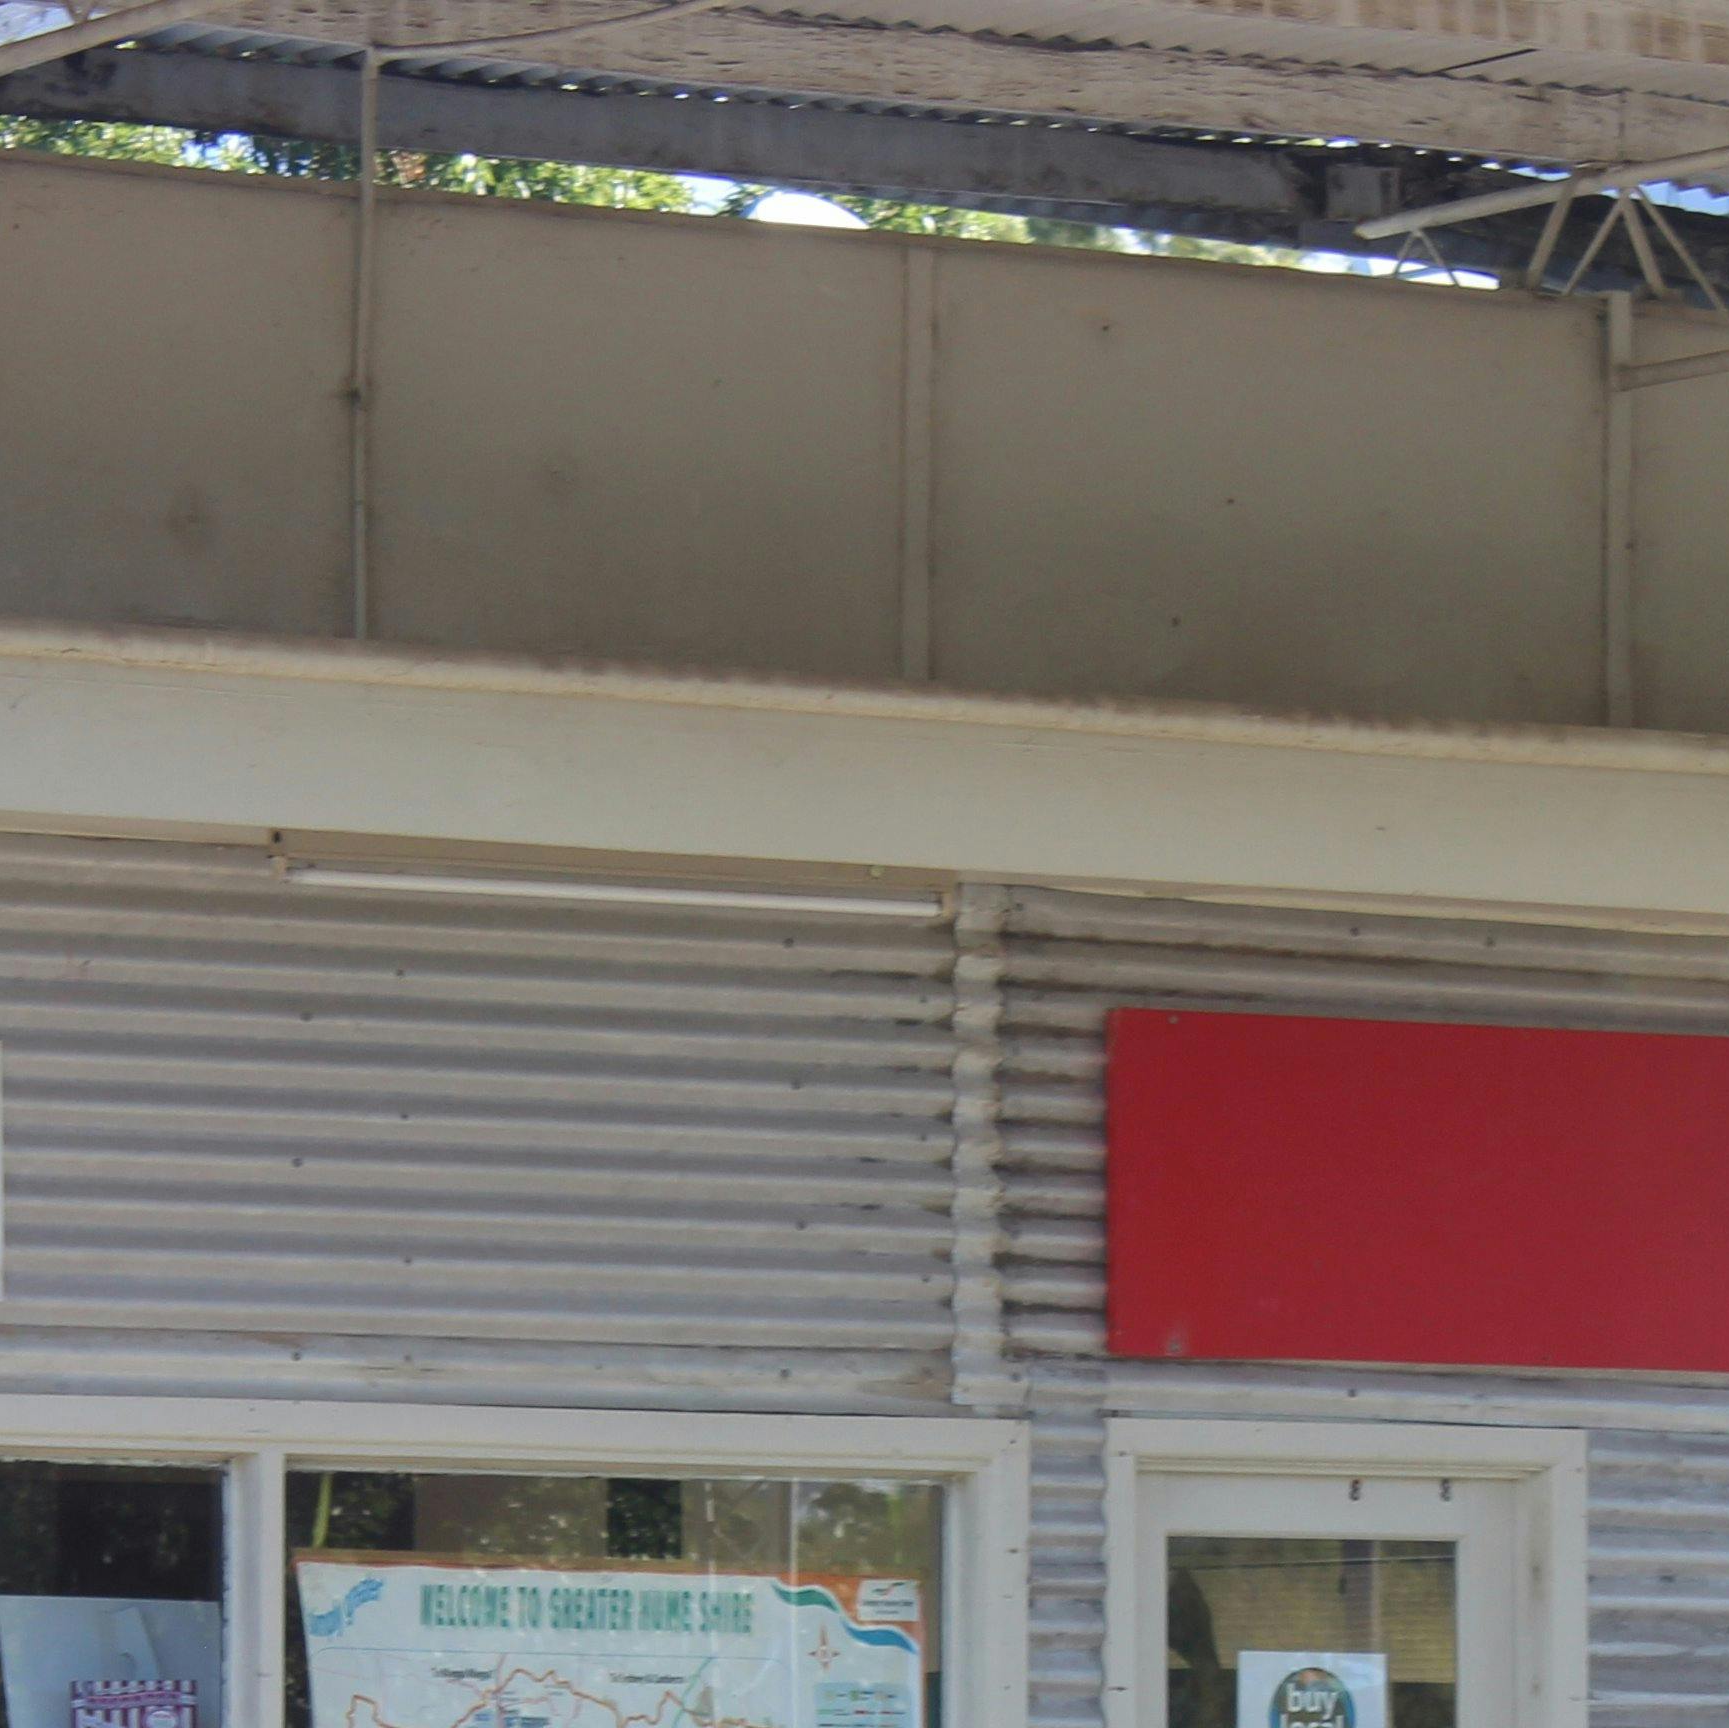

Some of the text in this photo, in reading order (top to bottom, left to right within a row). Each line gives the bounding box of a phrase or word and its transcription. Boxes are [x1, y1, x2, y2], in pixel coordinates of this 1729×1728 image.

[420, 1584, 754, 1635] WELCOME TO GREATER HUME SHIRE
[1286, 1683, 1339, 1719] buy
